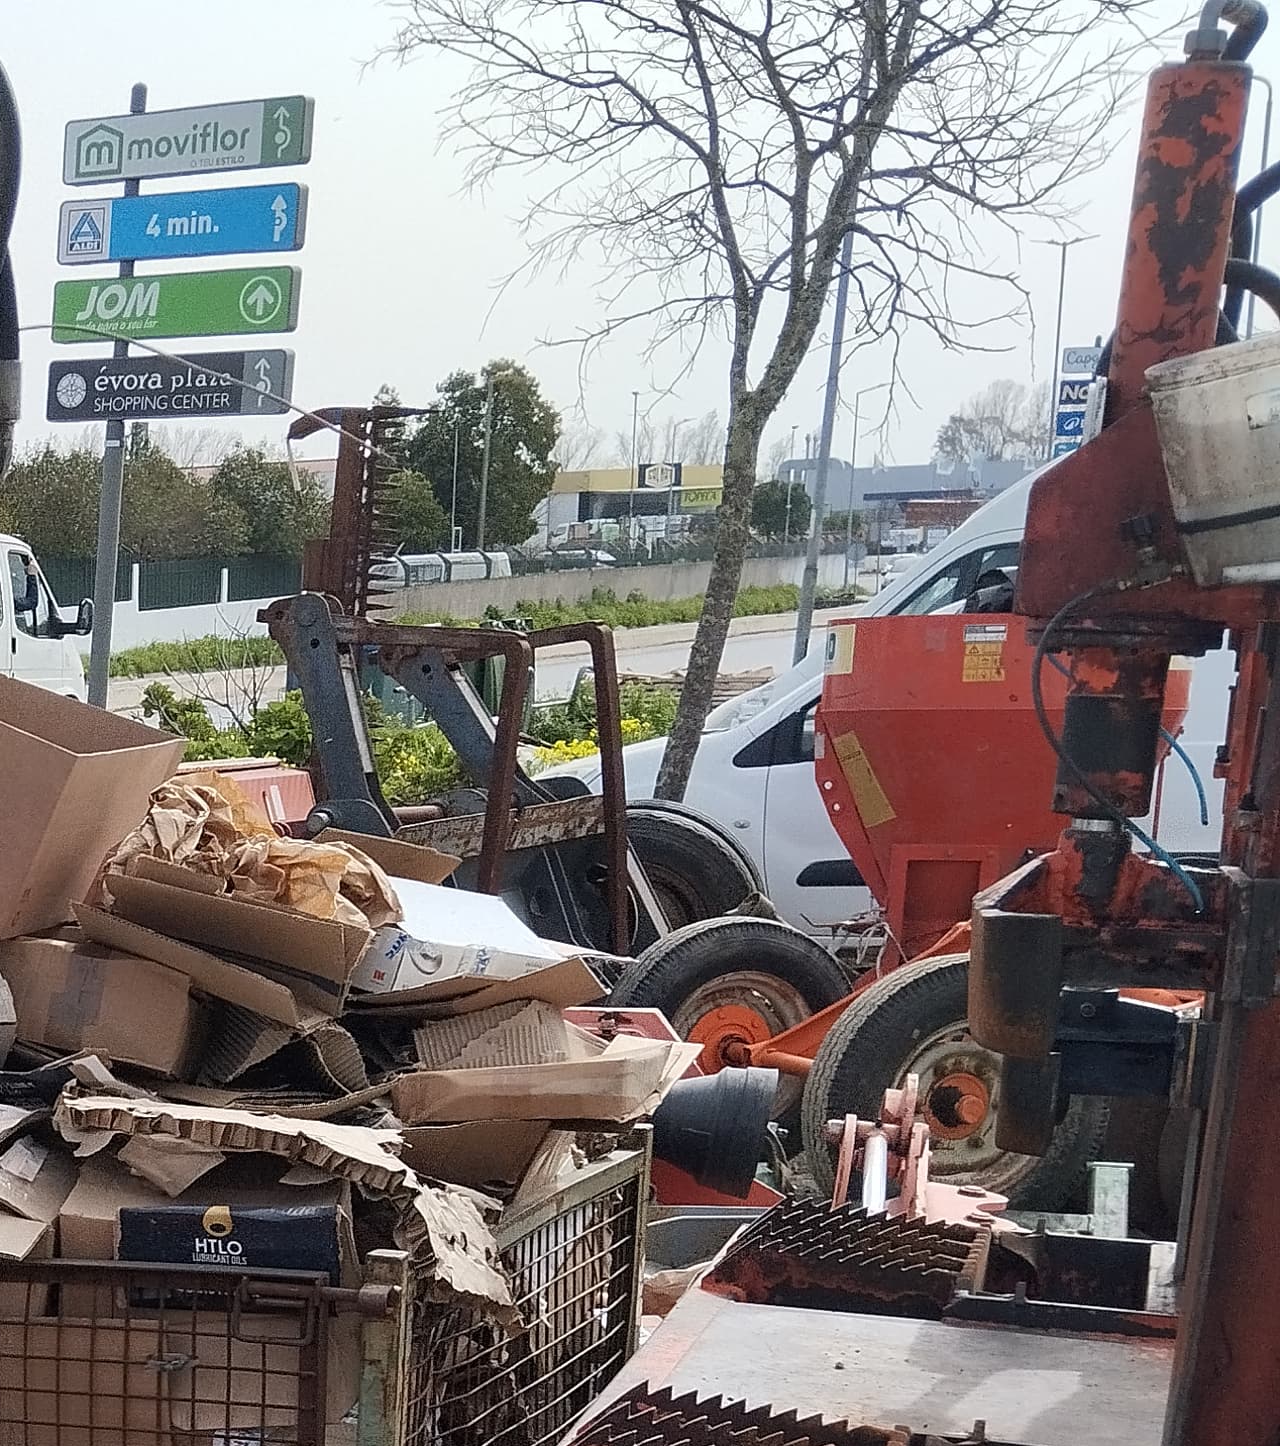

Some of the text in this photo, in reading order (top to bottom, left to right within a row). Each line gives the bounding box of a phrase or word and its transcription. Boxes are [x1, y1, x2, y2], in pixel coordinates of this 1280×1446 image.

[128, 122, 251, 161] moviflor
[216, 155, 246, 167] ESTILO
[145, 212, 220, 238] 4 min.
[71, 241, 98, 251] ALDI
[76, 282, 160, 320] JOM
[94, 368, 233, 392] évora plaza
[94, 392, 230, 412] SHOPPING CENTER
[195, 1238, 243, 1255] HTLO
[192, 1253, 248, 1266] LUBRICANT OILS
